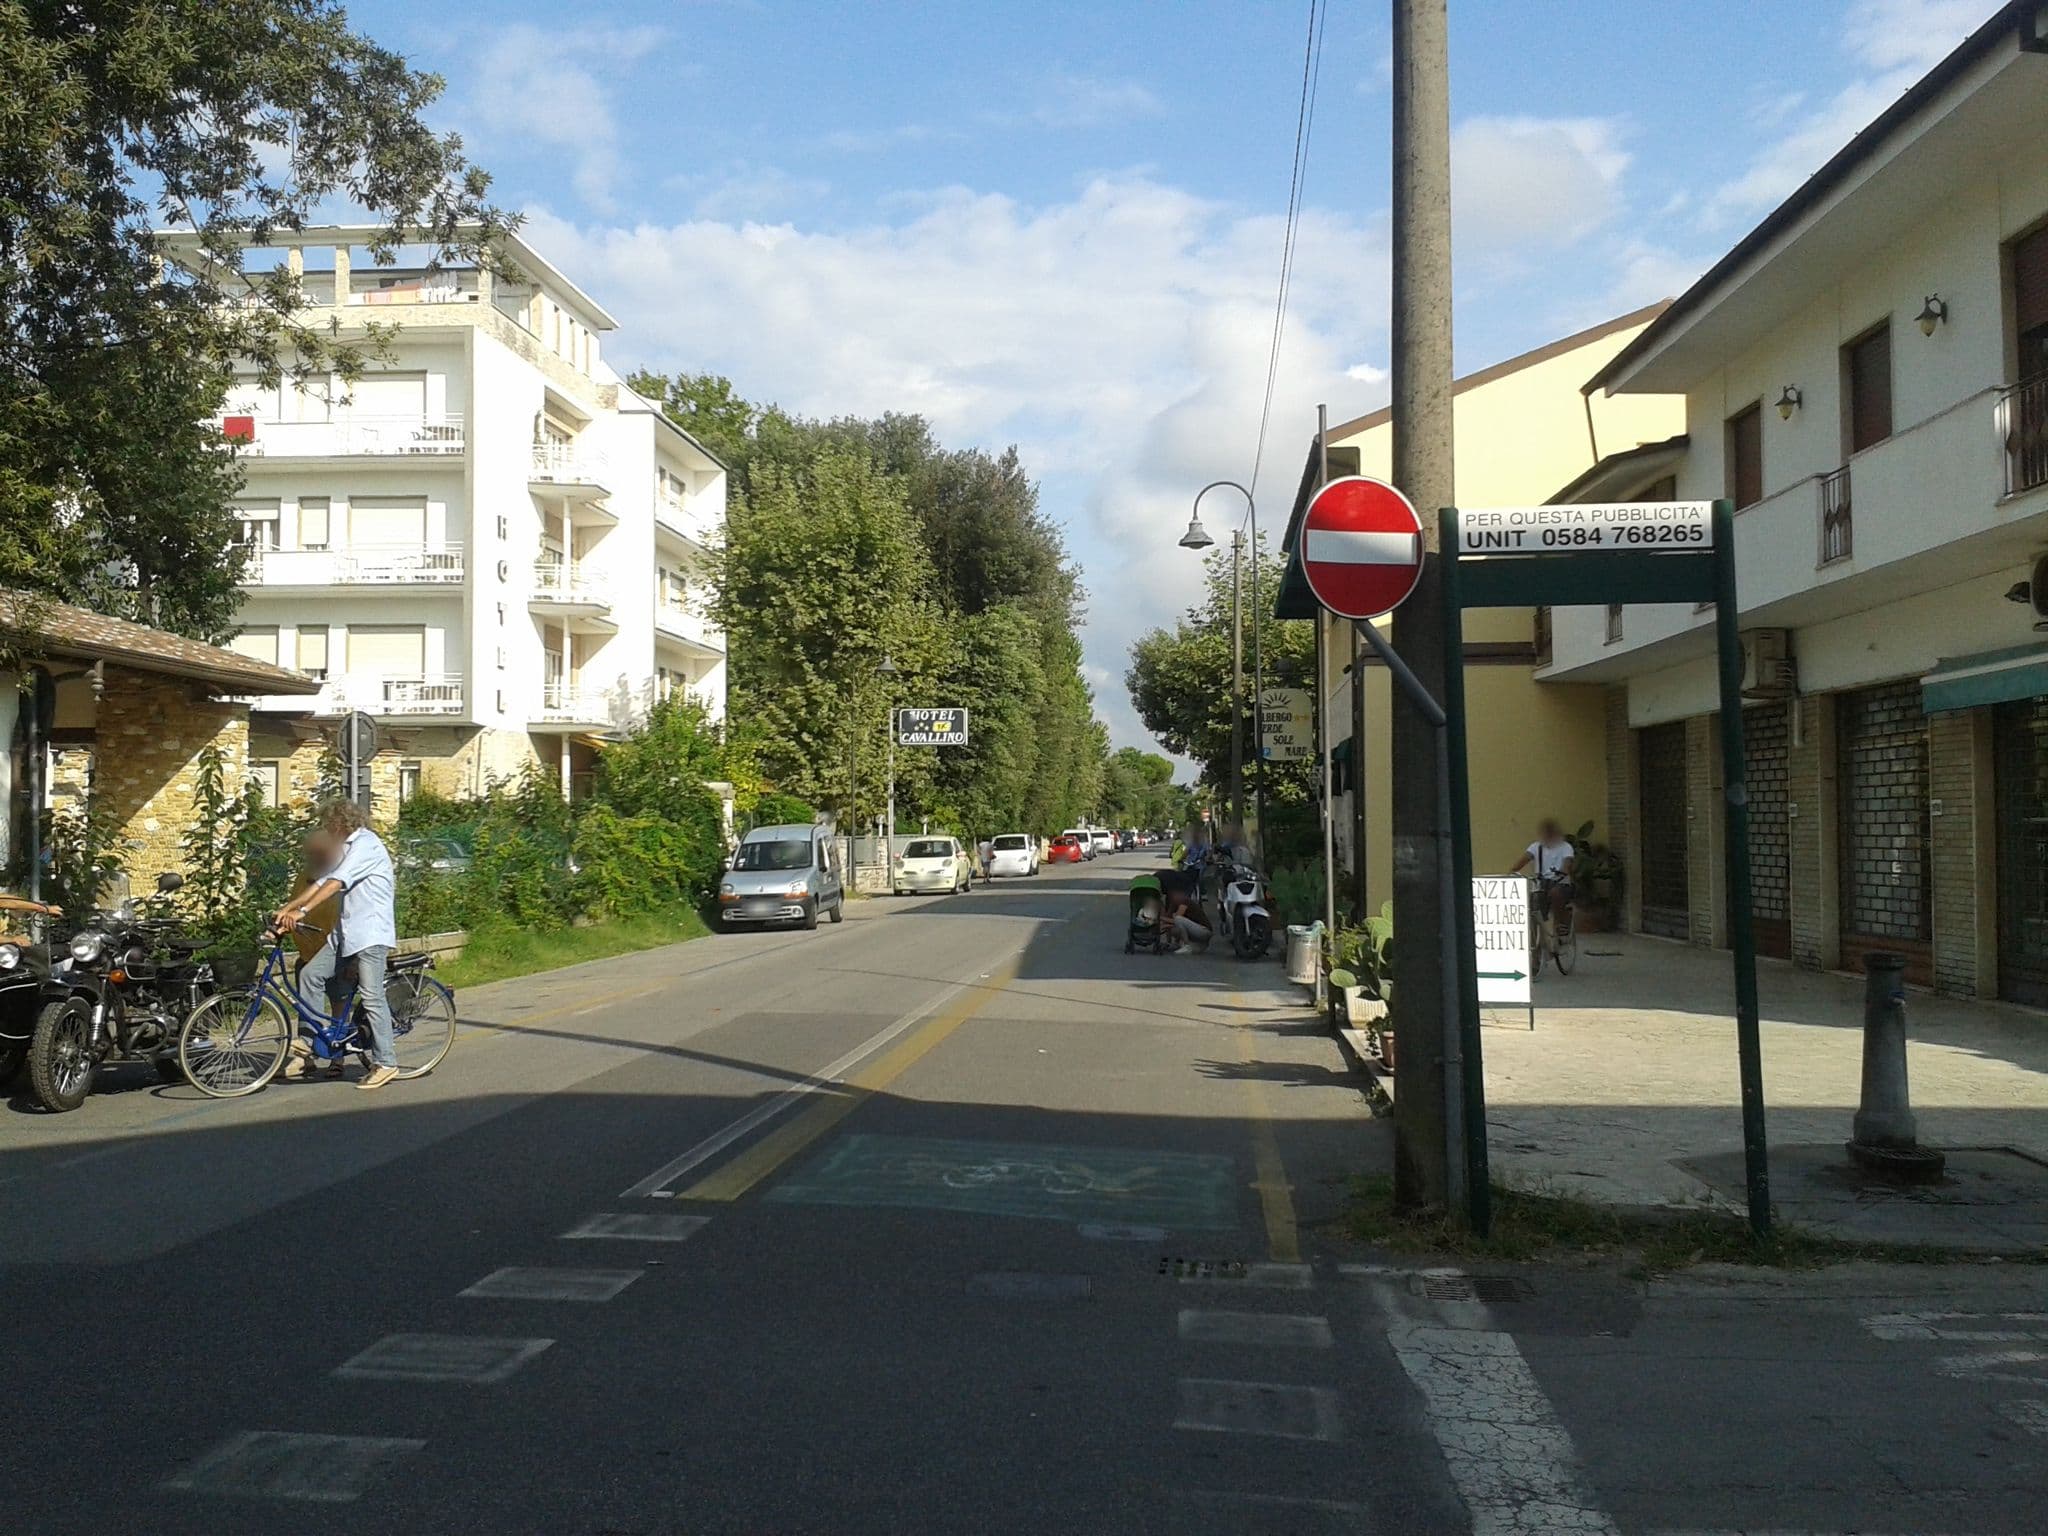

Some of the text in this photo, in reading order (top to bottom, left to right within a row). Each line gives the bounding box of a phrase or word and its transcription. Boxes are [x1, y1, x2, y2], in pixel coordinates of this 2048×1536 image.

[1465, 506, 1705, 527] PER QUESTA PUBBLICITA'
[1466, 524, 1704, 549] UNIT 0584 768265
[908, 710, 956, 721] HOTEL
[901, 732, 964, 745] CAVALLINO
[1272, 735, 1295, 745] SOLE
